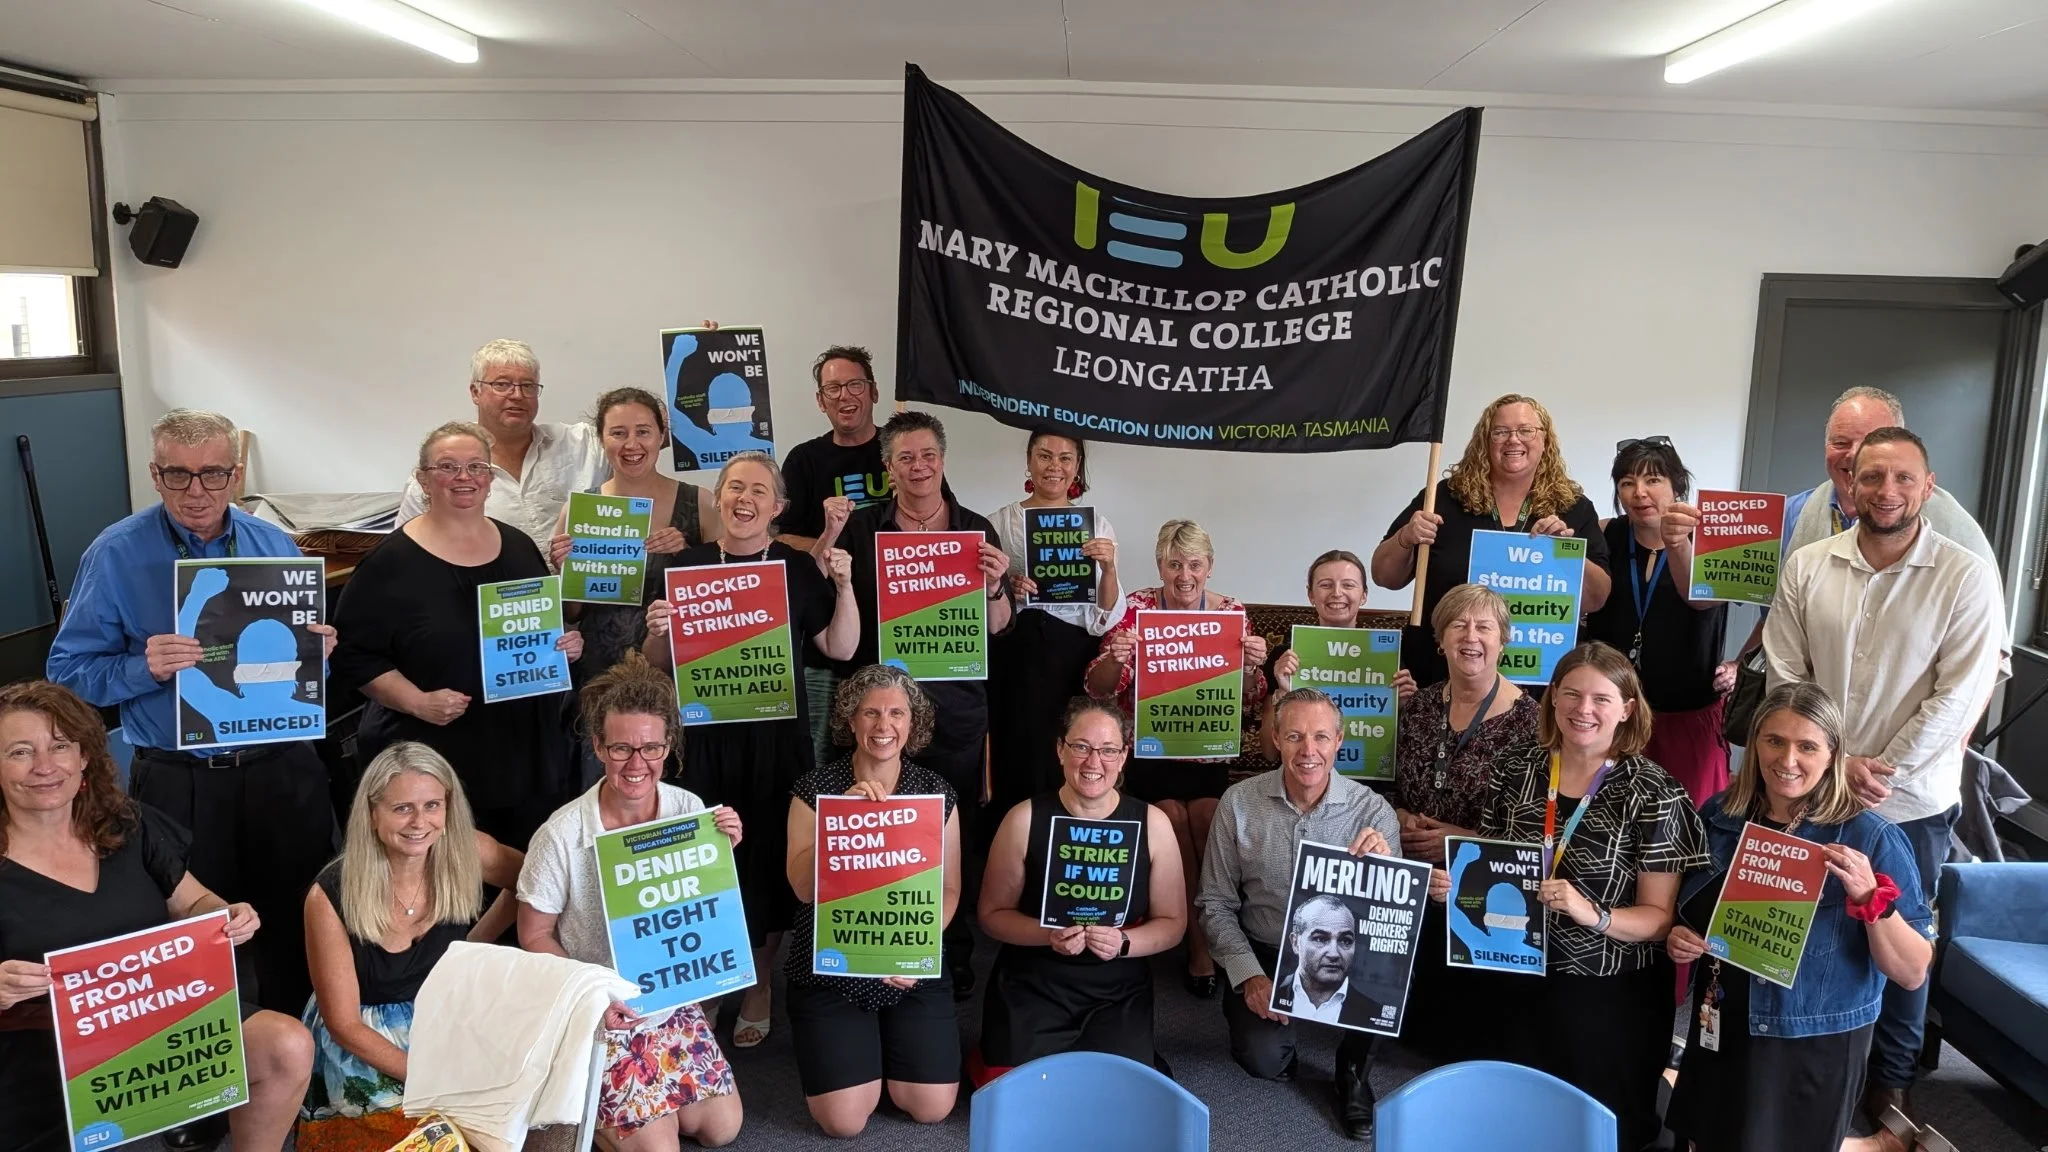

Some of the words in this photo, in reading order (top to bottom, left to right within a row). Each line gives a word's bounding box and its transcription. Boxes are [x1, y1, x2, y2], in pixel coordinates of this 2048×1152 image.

[1074, 180, 1295, 269] IEU
[918, 219, 1018, 274] MARY
[1025, 251, 1246, 312] MACKILLOP
[1256, 257, 1442, 310] CATHOLIC
[986, 282, 1178, 347] REGIONAL
[1189, 311, 1352, 350] COLLEGE
[734, 334, 760, 346] WE
[707, 350, 761, 363] WON'T
[744, 365, 763, 377] BE
[1053, 345, 1273, 393] LEONGATHA
[959, 379, 1049, 418] INDEPENDENT
[1053, 407, 1149, 438] EDUCATION
[1154, 423, 1213, 441] UNION
[1218, 423, 1297, 441] VICTORIA
[1303, 416, 1390, 438] TASMANIA
[835, 471, 889, 499] IEU
[596, 505, 623, 518] We
[1702, 499, 1768, 512] BLOCKED
[1038, 514, 1083, 527] WE'D
[1702, 513, 1743, 523] FROM
[574, 523, 621, 537] stand
[625, 525, 640, 537] in
[1032, 530, 1089, 544] STRIKE
[1704, 525, 1772, 536] STRIKING.
[572, 544, 641, 557] solidarity
[883, 541, 961, 562] BLOCKED
[1040, 548, 1053, 561] IF
[1057, 548, 1084, 560] WE
[1508, 546, 1544, 564] We
[1561, 542, 1579, 550] IEU
[1743, 549, 1776, 562] STILL
[572, 560, 608, 574] with
[611, 564, 637, 575] the
[886, 561, 935, 578] FROM
[1034, 564, 1091, 577] COULD
[1704, 559, 1774, 574] STANDING
[283, 570, 316, 586] WE
[888, 573, 971, 594] STRIKING.
[1478, 572, 1542, 591] stand
[1547, 574, 1567, 592] in
[1704, 571, 1740, 582] WITH
[1744, 574, 1773, 587] AEU.
[589, 583, 617, 592] AEU
[674, 574, 761, 601] BLOCKED
[242, 590, 317, 606] WON'T
[489, 597, 553, 618] DENIED
[678, 597, 733, 619] FROM
[939, 608, 979, 620] STILL
[1509, 600, 1570, 621] darity
[292, 610, 317, 625] BE
[503, 616, 541, 633] OUR
[682, 609, 774, 636] STRIKING.
[893, 625, 979, 637] STANDING
[1144, 622, 1221, 641] BLOCKED
[1528, 628, 1564, 645] the
[497, 632, 551, 651] RIGHT
[895, 642, 938, 654] WITH
[943, 641, 979, 653] AEU.
[1146, 641, 1194, 657] FROM
[1328, 641, 1362, 657] We
[512, 651, 536, 666] TO
[741, 646, 785, 660] STILL
[1499, 655, 1537, 668] AEU
[691, 663, 786, 681] STANDING
[1148, 655, 1229, 673] STRIKING.
[495, 665, 559, 687] STRIKE
[1300, 667, 1360, 684] stand
[1366, 668, 1385, 684] in
[694, 683, 742, 698] WITH
[747, 680, 787, 695] AEU.
[1196, 689, 1235, 700] STILL
[1150, 705, 1235, 716] STANDING
[1324, 693, 1388, 712] darity
[219, 714, 320, 734] SILENCED!
[1151, 721, 1194, 733] WITH
[1198, 721, 1234, 732] AEU.
[1350, 721, 1385, 738] the
[186, 733, 203, 741] IEU
[1336, 748, 1359, 762] EU
[825, 808, 918, 831] BLOCKED
[626, 830, 662, 844] VICTORIAN
[662, 822, 696, 835] CATHOLIC
[633, 837, 672, 851] EDUCATION
[672, 832, 693, 842] STAFF
[827, 832, 885, 851] FROM
[1070, 826, 1124, 844] WE'D
[1059, 845, 1129, 863] STRIKE
[1516, 850, 1539, 863] WE
[1745, 838, 1809, 861] BLOCKED
[615, 843, 719, 886] DENIED
[829, 848, 927, 872] STRIKING.
[1489, 861, 1540, 877] WON'T
[1742, 853, 1781, 872] FROM
[1065, 864, 1083, 879] IF
[1087, 867, 1119, 882] WE
[1301, 855, 1420, 906] MERLINO:
[1738, 868, 1808, 895] STRIKING.
[638, 876, 701, 908] OUR
[1055, 882, 1124, 900] COULD
[1522, 879, 1540, 891] BE
[887, 891, 935, 905] STILL
[632, 897, 719, 939] RIGHT
[832, 910, 934, 925] STANDING
[1369, 905, 1413, 925] DENYING
[1768, 907, 1805, 930] STILL
[1359, 919, 1412, 939] WORKERS'
[1726, 908, 1800, 945] STANDING
[661, 932, 702, 958] TO
[833, 930, 884, 945] WITH
[890, 931, 934, 945] AEU.
[1370, 937, 1409, 955] RIGHTS!
[1723, 923, 1760, 947] WITH
[1761, 939, 1795, 961] AEU.
[63, 935, 195, 992] BLOCKED
[822, 958, 839, 967] IEU
[1474, 950, 1542, 966] SILENCED!
[638, 949, 737, 995] STRIKE
[69, 973, 154, 1015] FROM
[1279, 998, 1292, 1006] IEU
[76, 979, 215, 1036] STRIKING.
[167, 1018, 231, 1050] STILL
[90, 1038, 232, 1094] STANDING
[95, 1080, 170, 1115] WITH
[177, 1061, 236, 1092] AEU.
[84, 1130, 110, 1146] IEU
